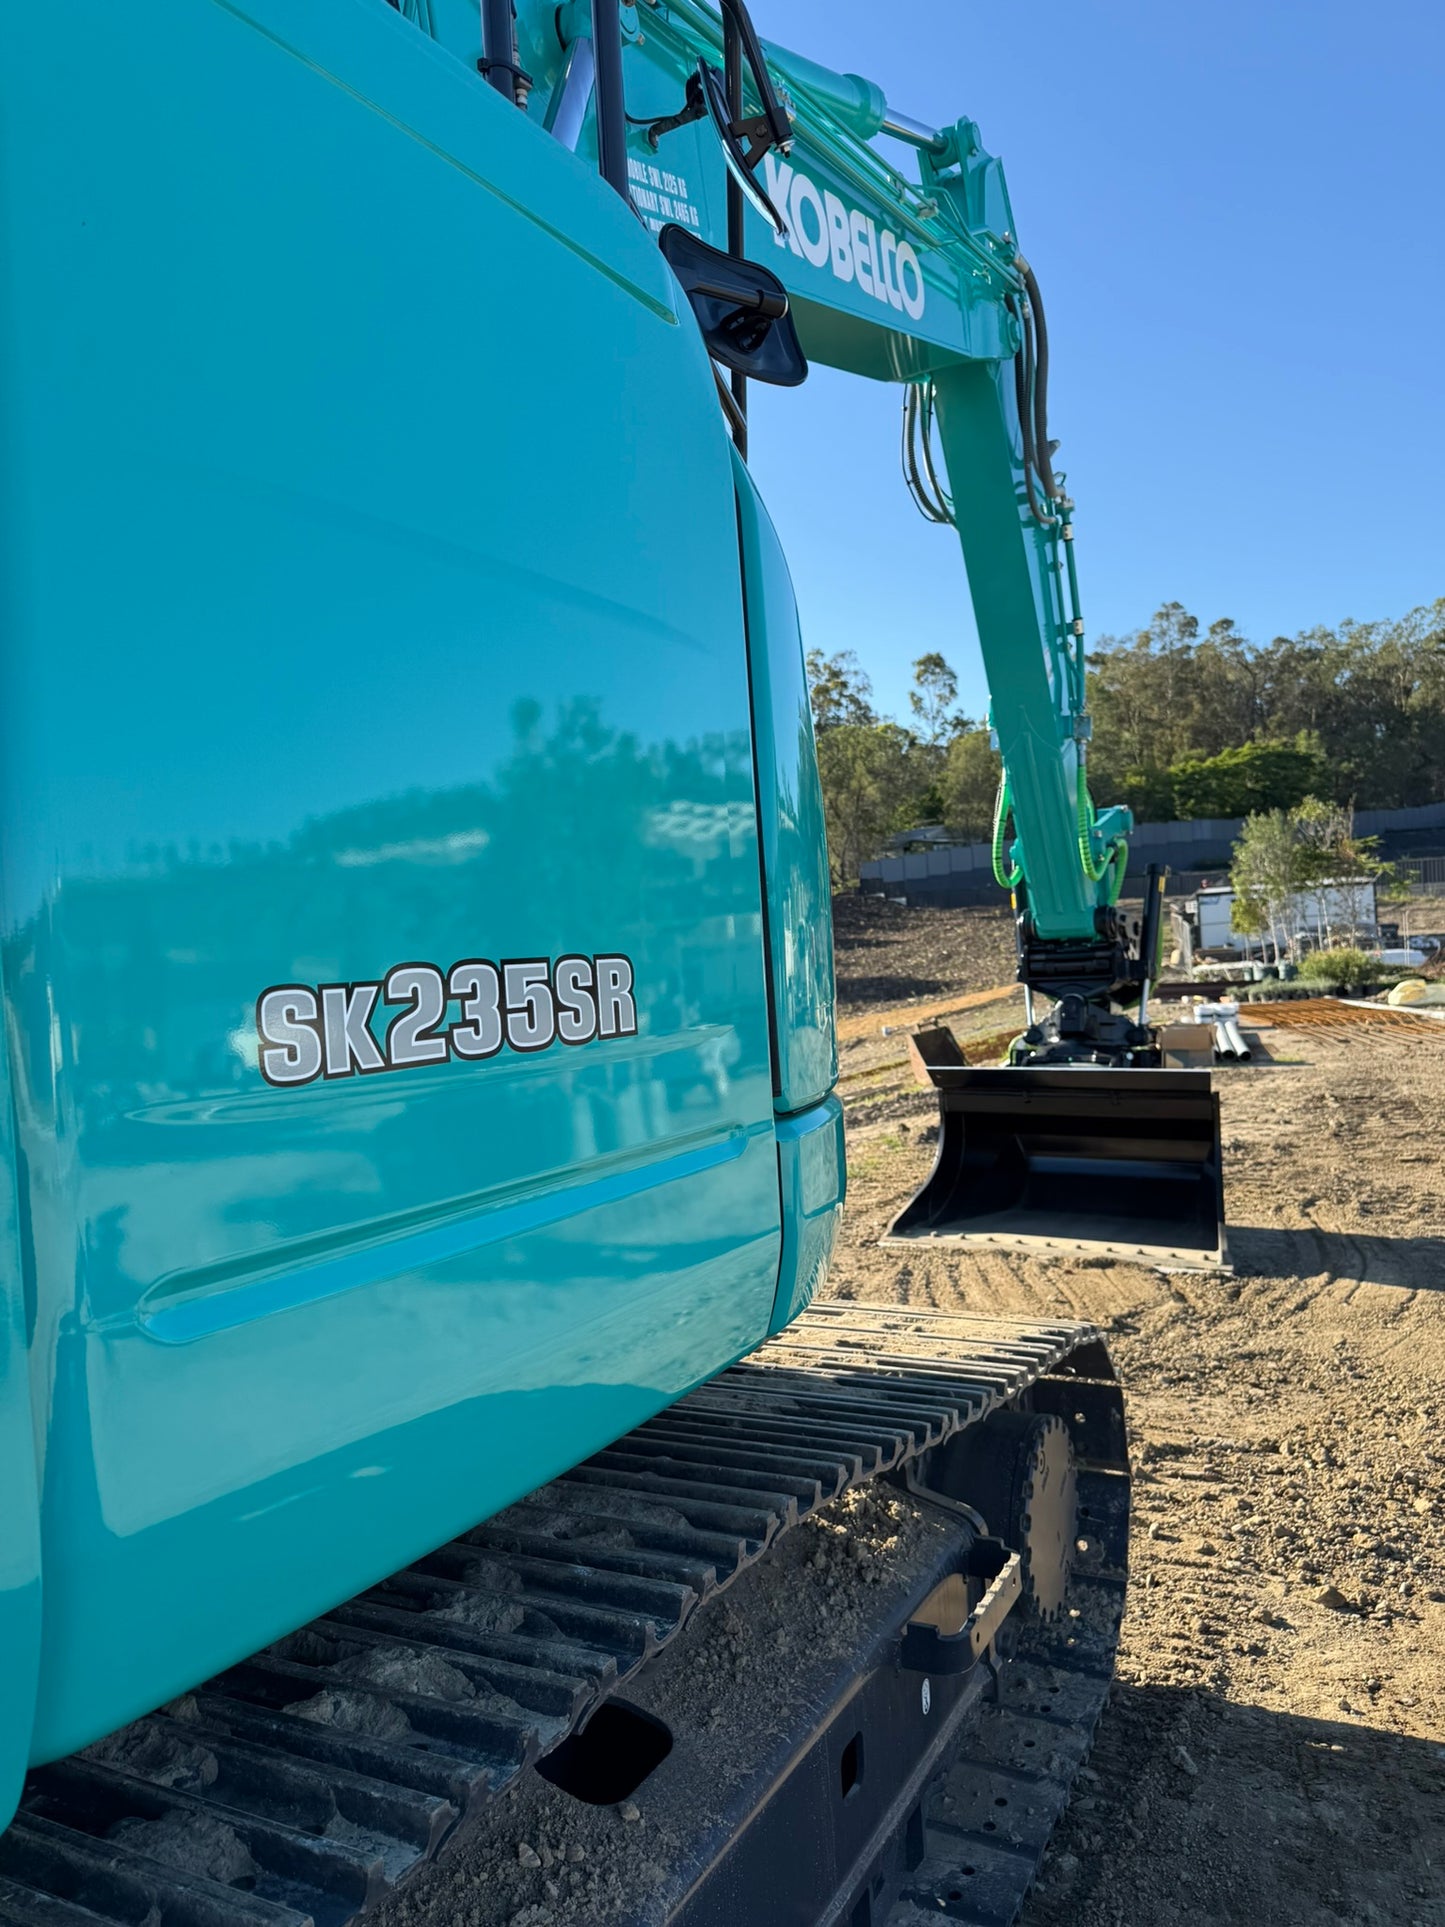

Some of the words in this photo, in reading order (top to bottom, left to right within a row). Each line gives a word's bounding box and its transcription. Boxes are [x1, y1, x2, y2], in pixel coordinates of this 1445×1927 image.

[648, 165, 663, 190] SWL
[677, 176, 688, 199] KG
[659, 194, 674, 218] SWL
[689, 205, 699, 227] KG
[764, 152, 925, 320] KOBELCO
[257, 954, 638, 1087] SK235SR
